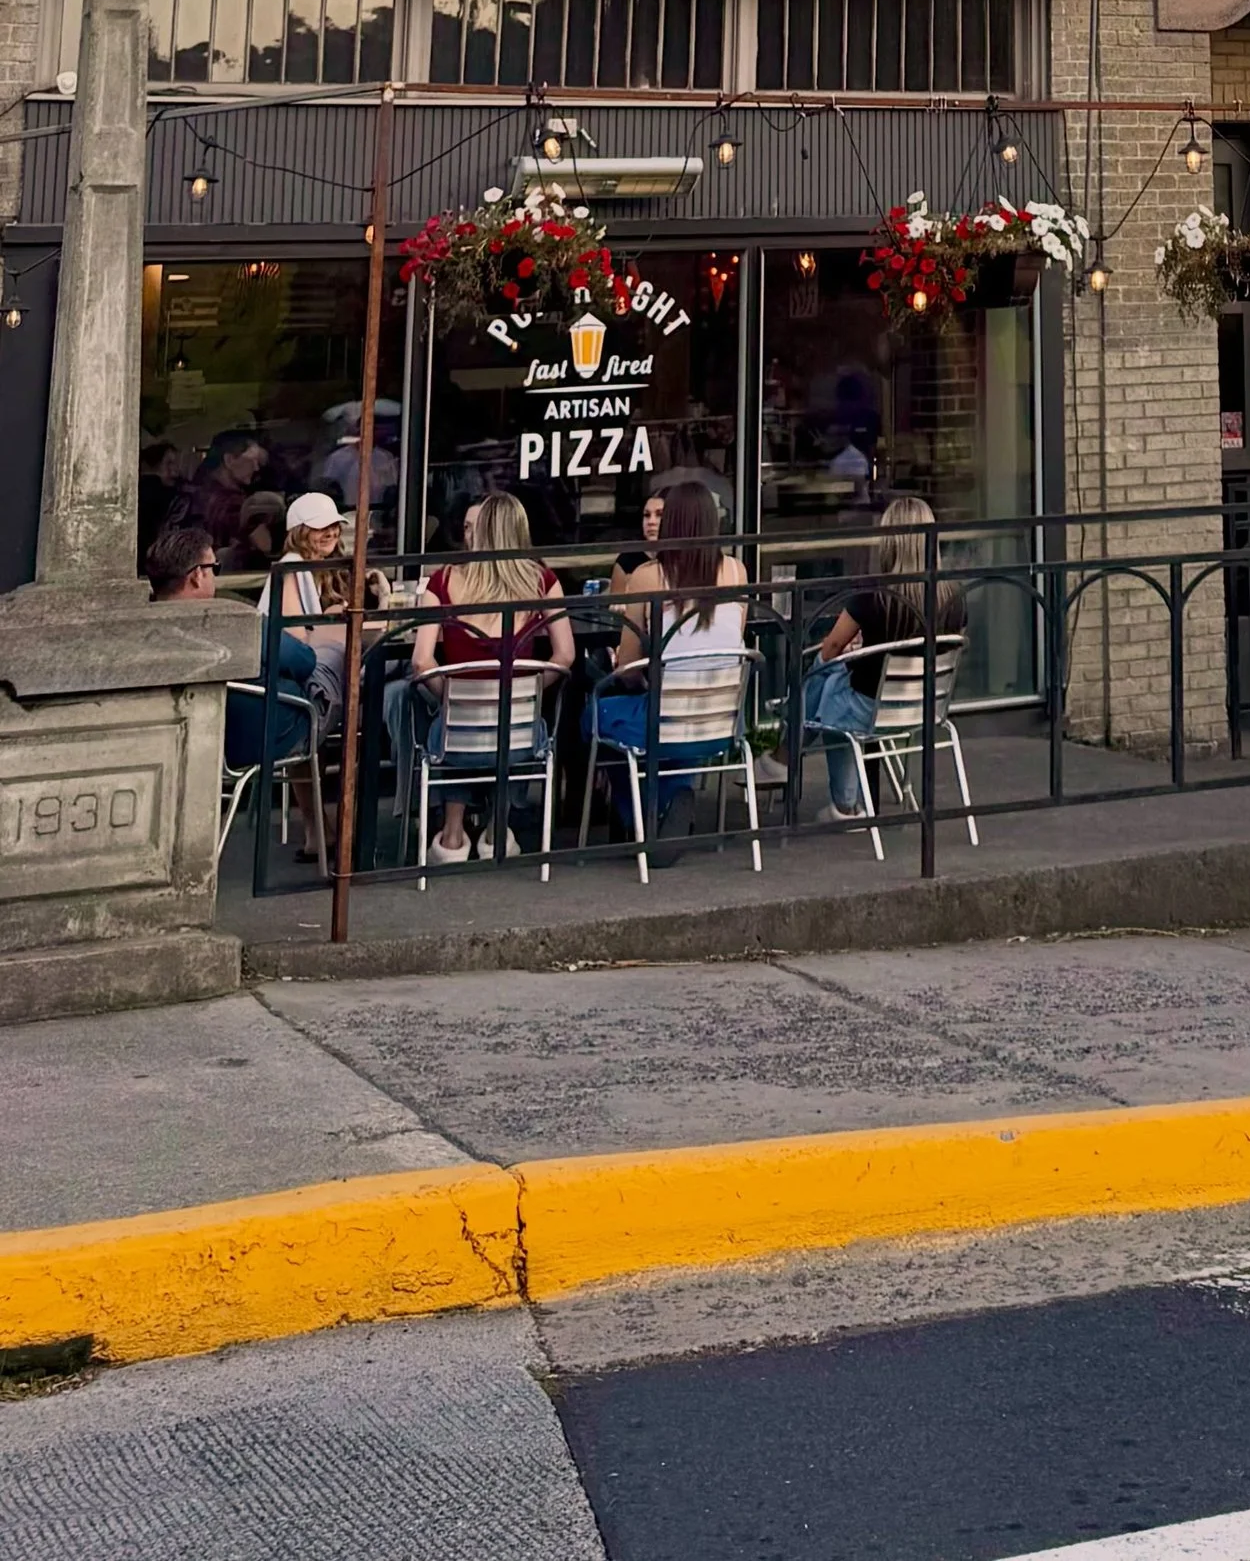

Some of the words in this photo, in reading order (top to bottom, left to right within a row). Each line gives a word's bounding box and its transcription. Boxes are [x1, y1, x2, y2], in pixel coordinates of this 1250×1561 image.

[522, 358, 568, 387] fast
[601, 354, 654, 382] fired
[543, 396, 631, 421] ARTISAN
[518, 425, 654, 481] PIZZA
[14, 788, 137, 844] 1930
